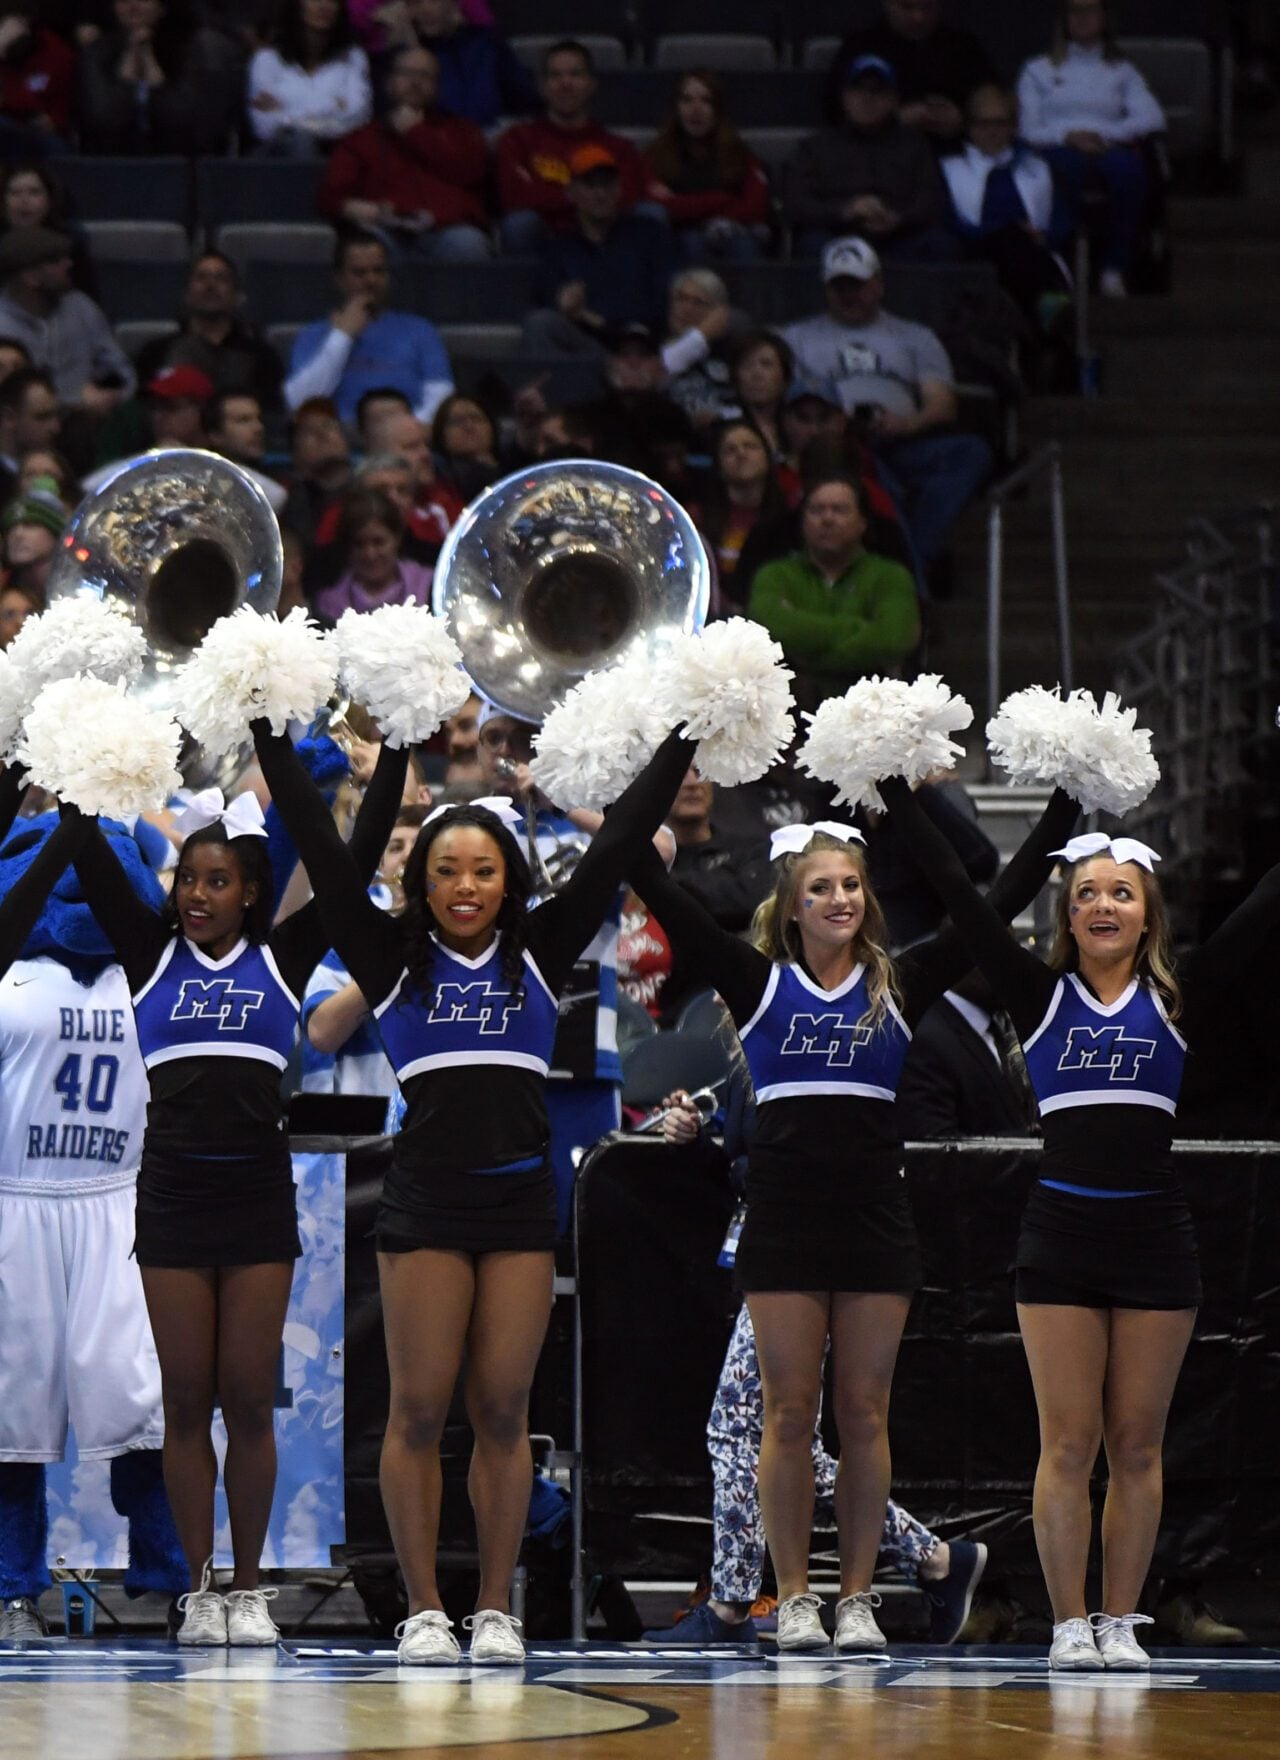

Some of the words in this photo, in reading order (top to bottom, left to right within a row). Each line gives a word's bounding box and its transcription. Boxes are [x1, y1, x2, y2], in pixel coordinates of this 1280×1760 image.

[59, 1007, 124, 1043] BLUE
[170, 979, 265, 1031] MT
[428, 981, 522, 1035] MT
[780, 1013, 874, 1067] MT
[1057, 1025, 1157, 1081] MT
[53, 1053, 120, 1115] 40
[26, 1123, 130, 1165] RAIDERS
